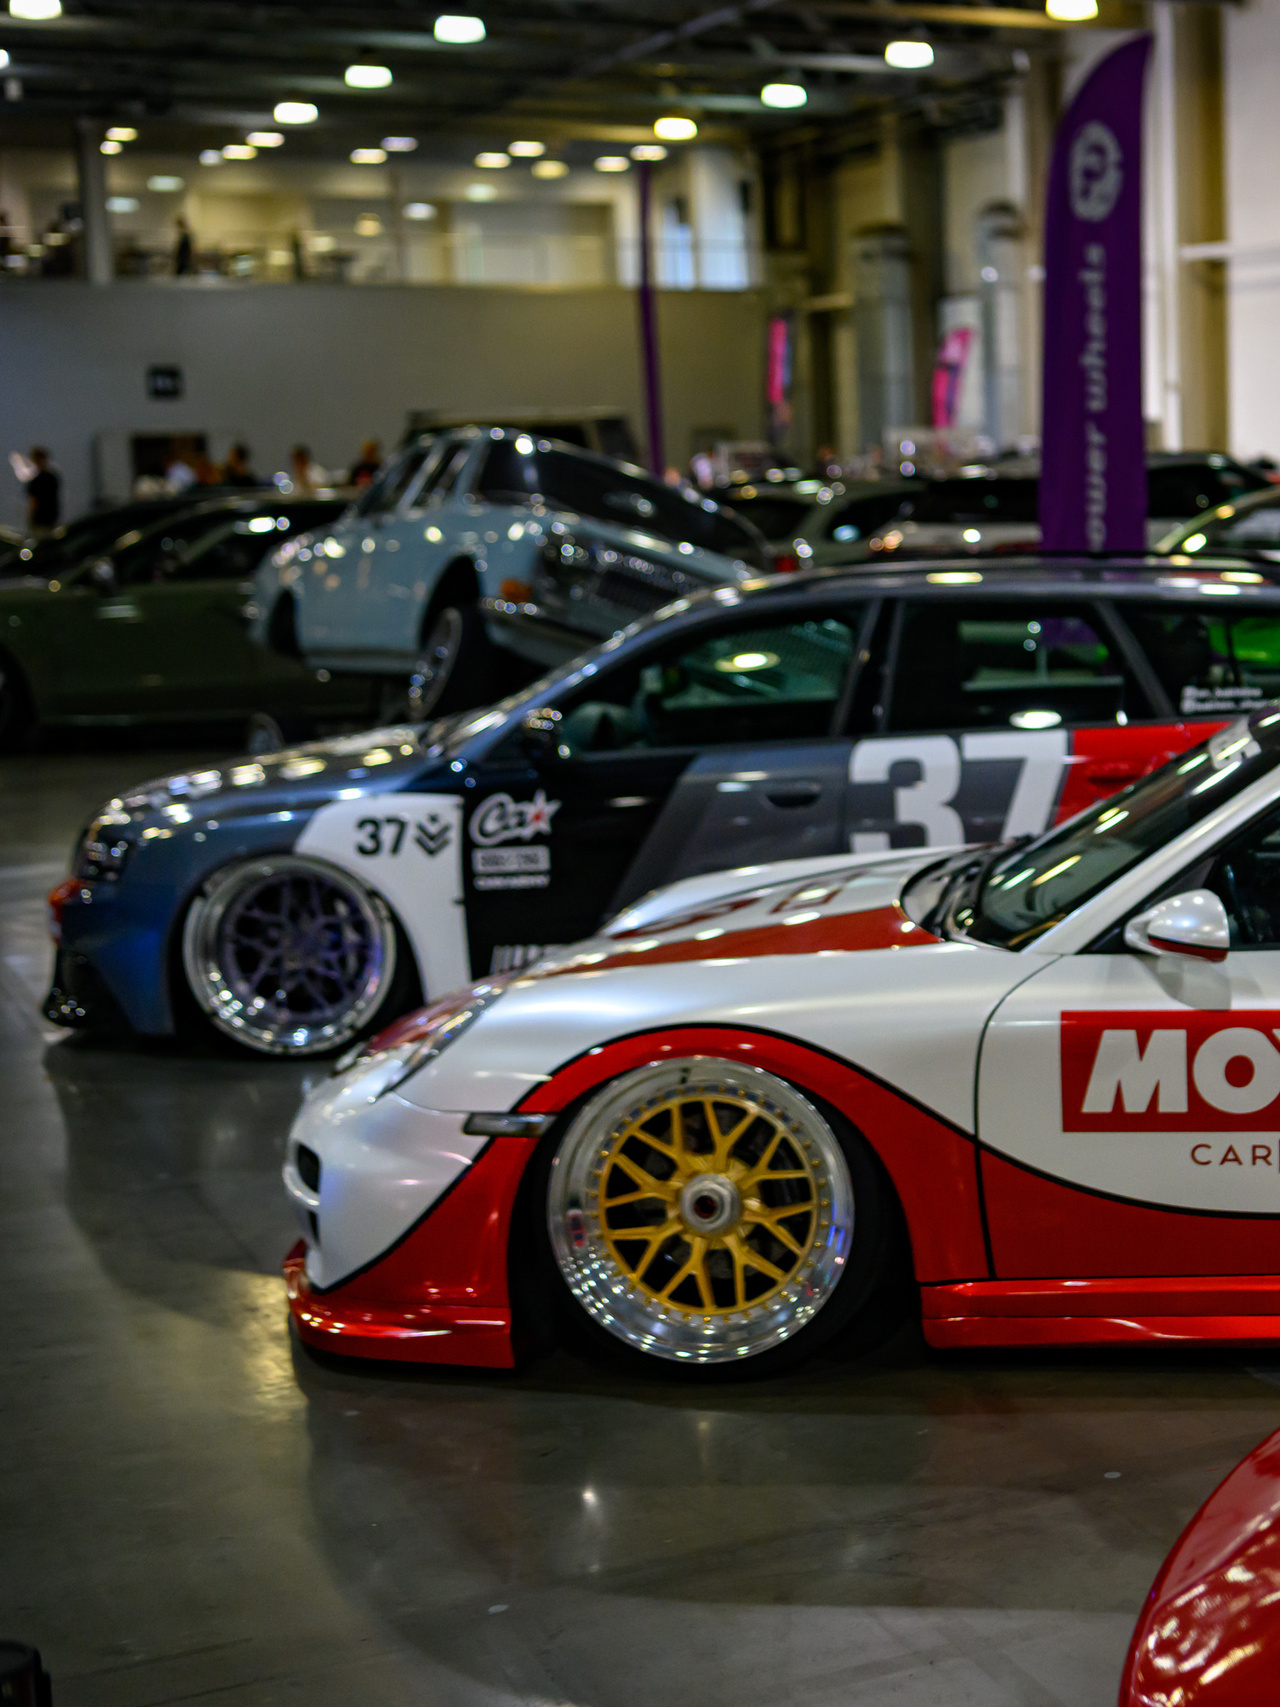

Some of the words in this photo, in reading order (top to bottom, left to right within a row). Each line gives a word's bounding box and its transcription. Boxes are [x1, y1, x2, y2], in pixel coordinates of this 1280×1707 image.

[1078, 242, 1107, 413] wheels
[1085, 420, 1107, 552] ower
[356, 815, 408, 857] 37
[849, 729, 1068, 852] 37
